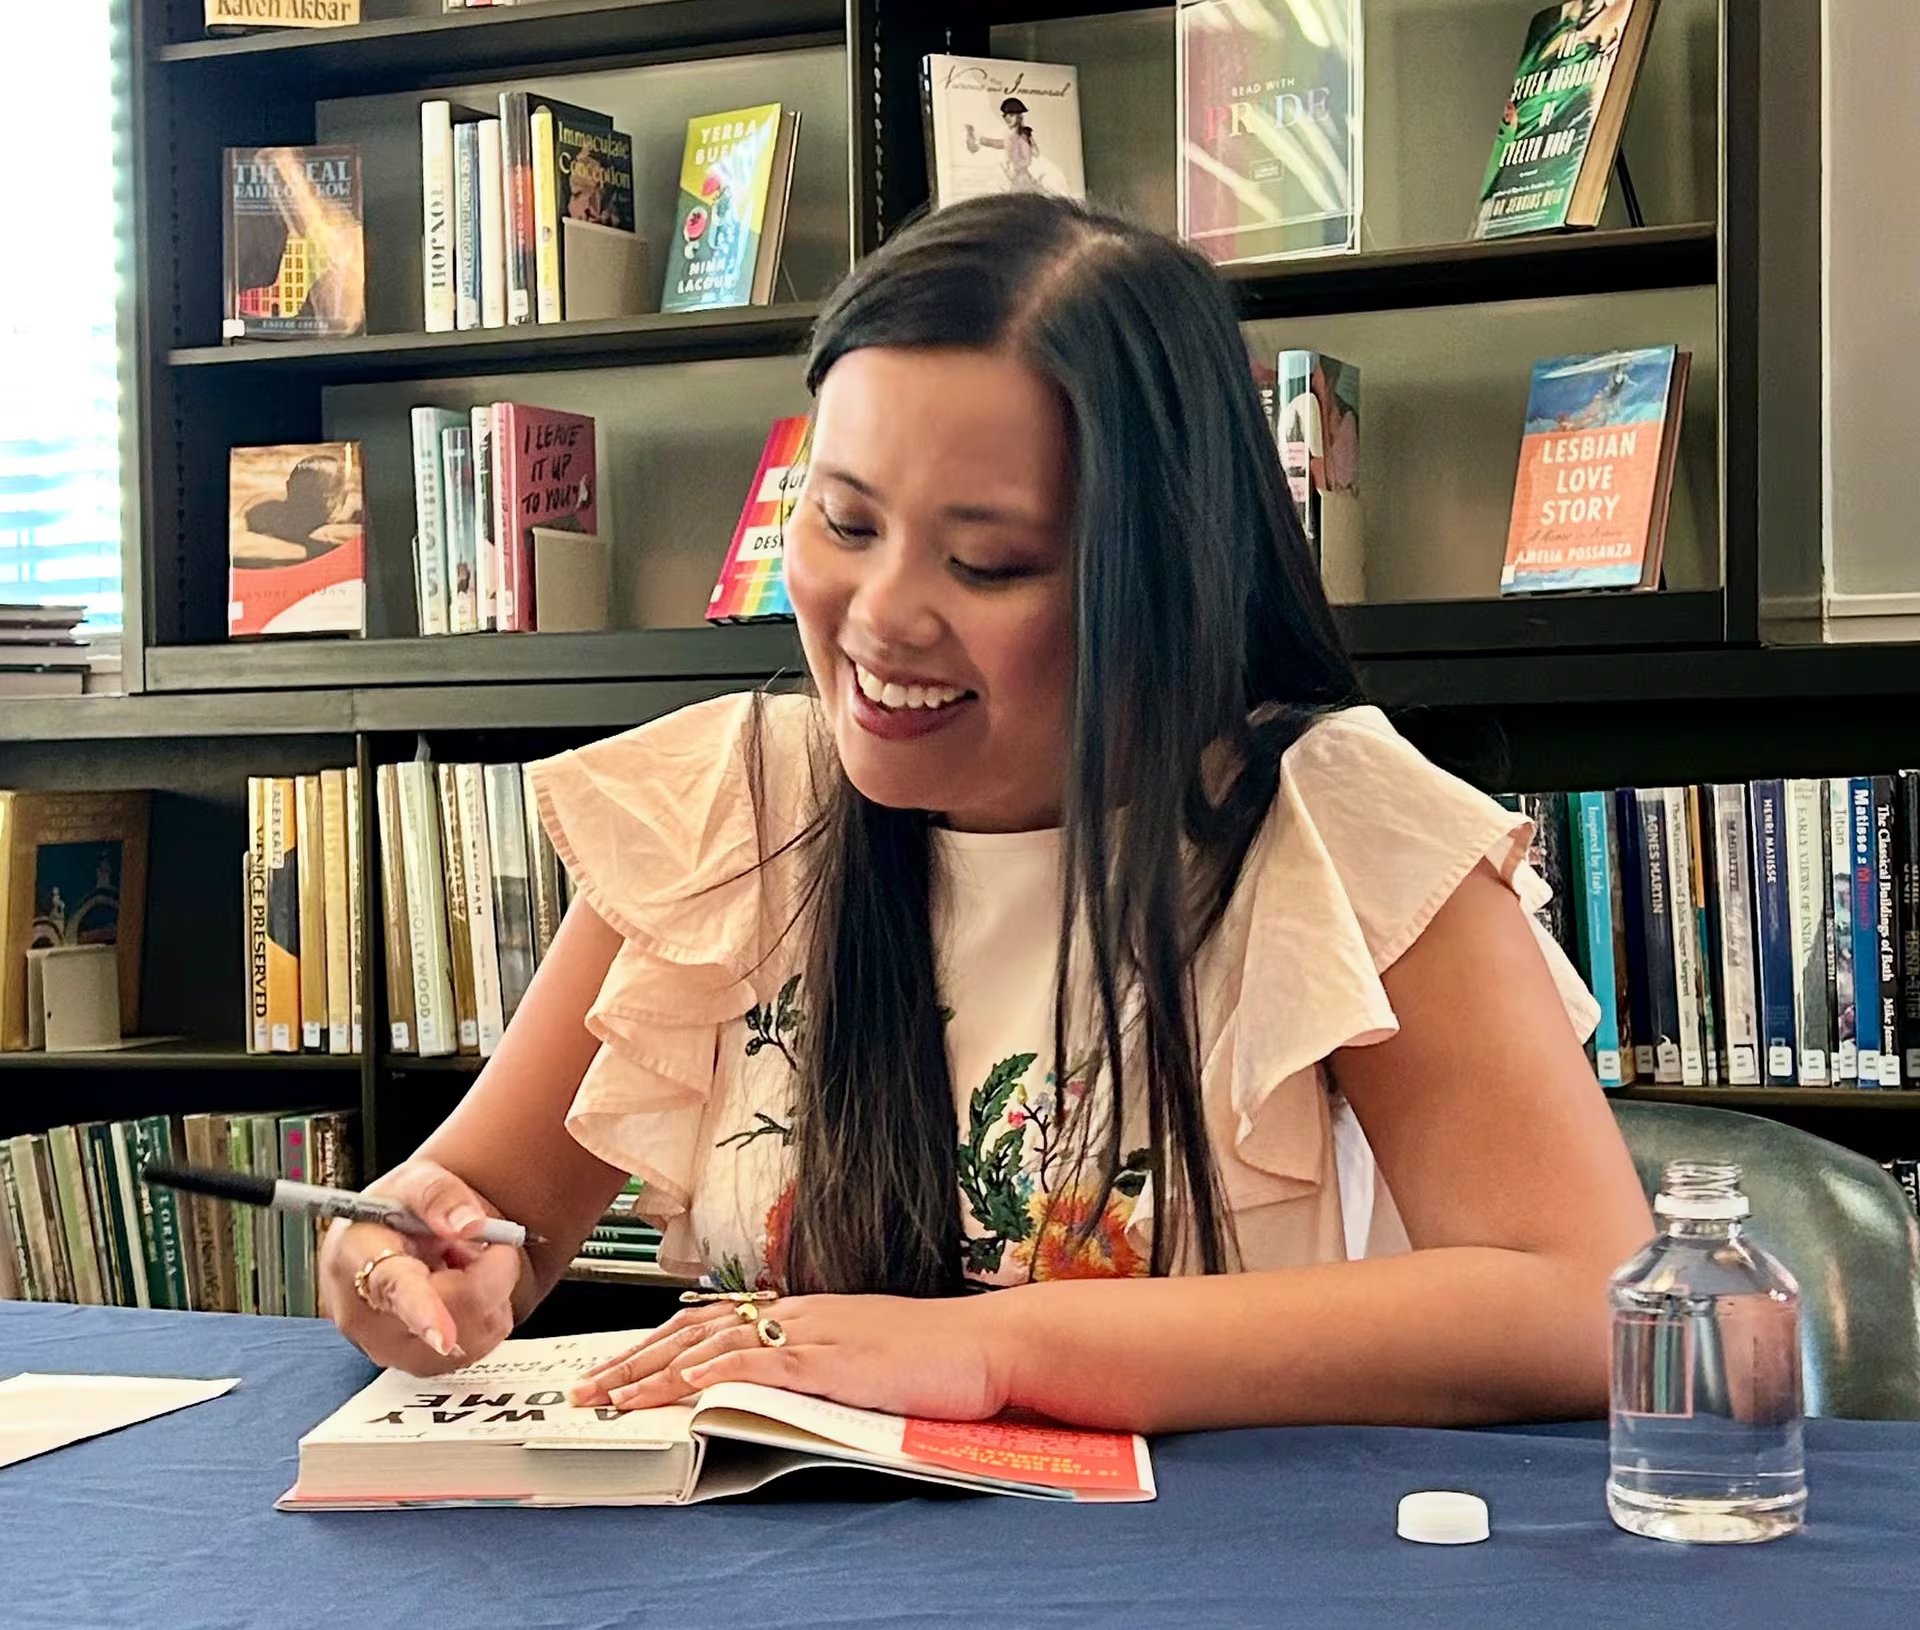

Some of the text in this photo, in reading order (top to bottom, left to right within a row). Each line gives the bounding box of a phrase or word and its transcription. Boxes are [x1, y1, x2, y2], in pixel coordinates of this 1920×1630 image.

[286, 0, 351, 21] Akbar
[1231, 77, 1295, 97] READ WITH
[1511, 71, 1548, 101] SEVEN
[1205, 87, 1331, 140] PRDE
[558, 121, 630, 160] Immaculate
[701, 119, 757, 145] YERBA
[1541, 128, 1576, 159] HUGO
[1499, 136, 1544, 167] EVELYN
[234, 160, 352, 184] THE EAL
[559, 151, 631, 190] Conception
[524, 424, 584, 453] I LEAVE
[1542, 430, 1637, 465] LESBIAN
[531, 453, 572, 482] IT UP
[778, 470, 807, 491] QUE
[1556, 464, 1615, 494] LOVE
[521, 493, 540, 514] TO
[1540, 495, 1622, 526] STORY
[1515, 543, 1633, 564] AMELIA POSSANZA
[272, 790, 283, 865] ALEX KATZ
[1585, 805, 1601, 853] Inspired
[1762, 799, 1775, 834] HENRI
[1833, 808, 1848, 846] Titian
[1854, 789, 1870, 853] Matisse
[1588, 854, 1601, 869] by
[1646, 814, 1664, 914] AGNES MARTIN
[1764, 836, 1778, 883] MATISSE
[1799, 851, 1813, 892] VIEWS
[1589, 871, 1603, 896] Italy
[1877, 804, 1895, 982] The Classical Buildings of Bath
[1801, 895, 1812, 912] OF
[253, 905, 268, 1018] PRESERVED
[412, 903, 432, 1019] HOLLYWOOD
[1678, 959, 1691, 997] Sargent
[1883, 997, 1896, 1023] Mike
[158, 1192, 177, 1278] LORIDA
[366, 1406, 625, 1425] A WAY
[403, 1392, 567, 1408] OME
